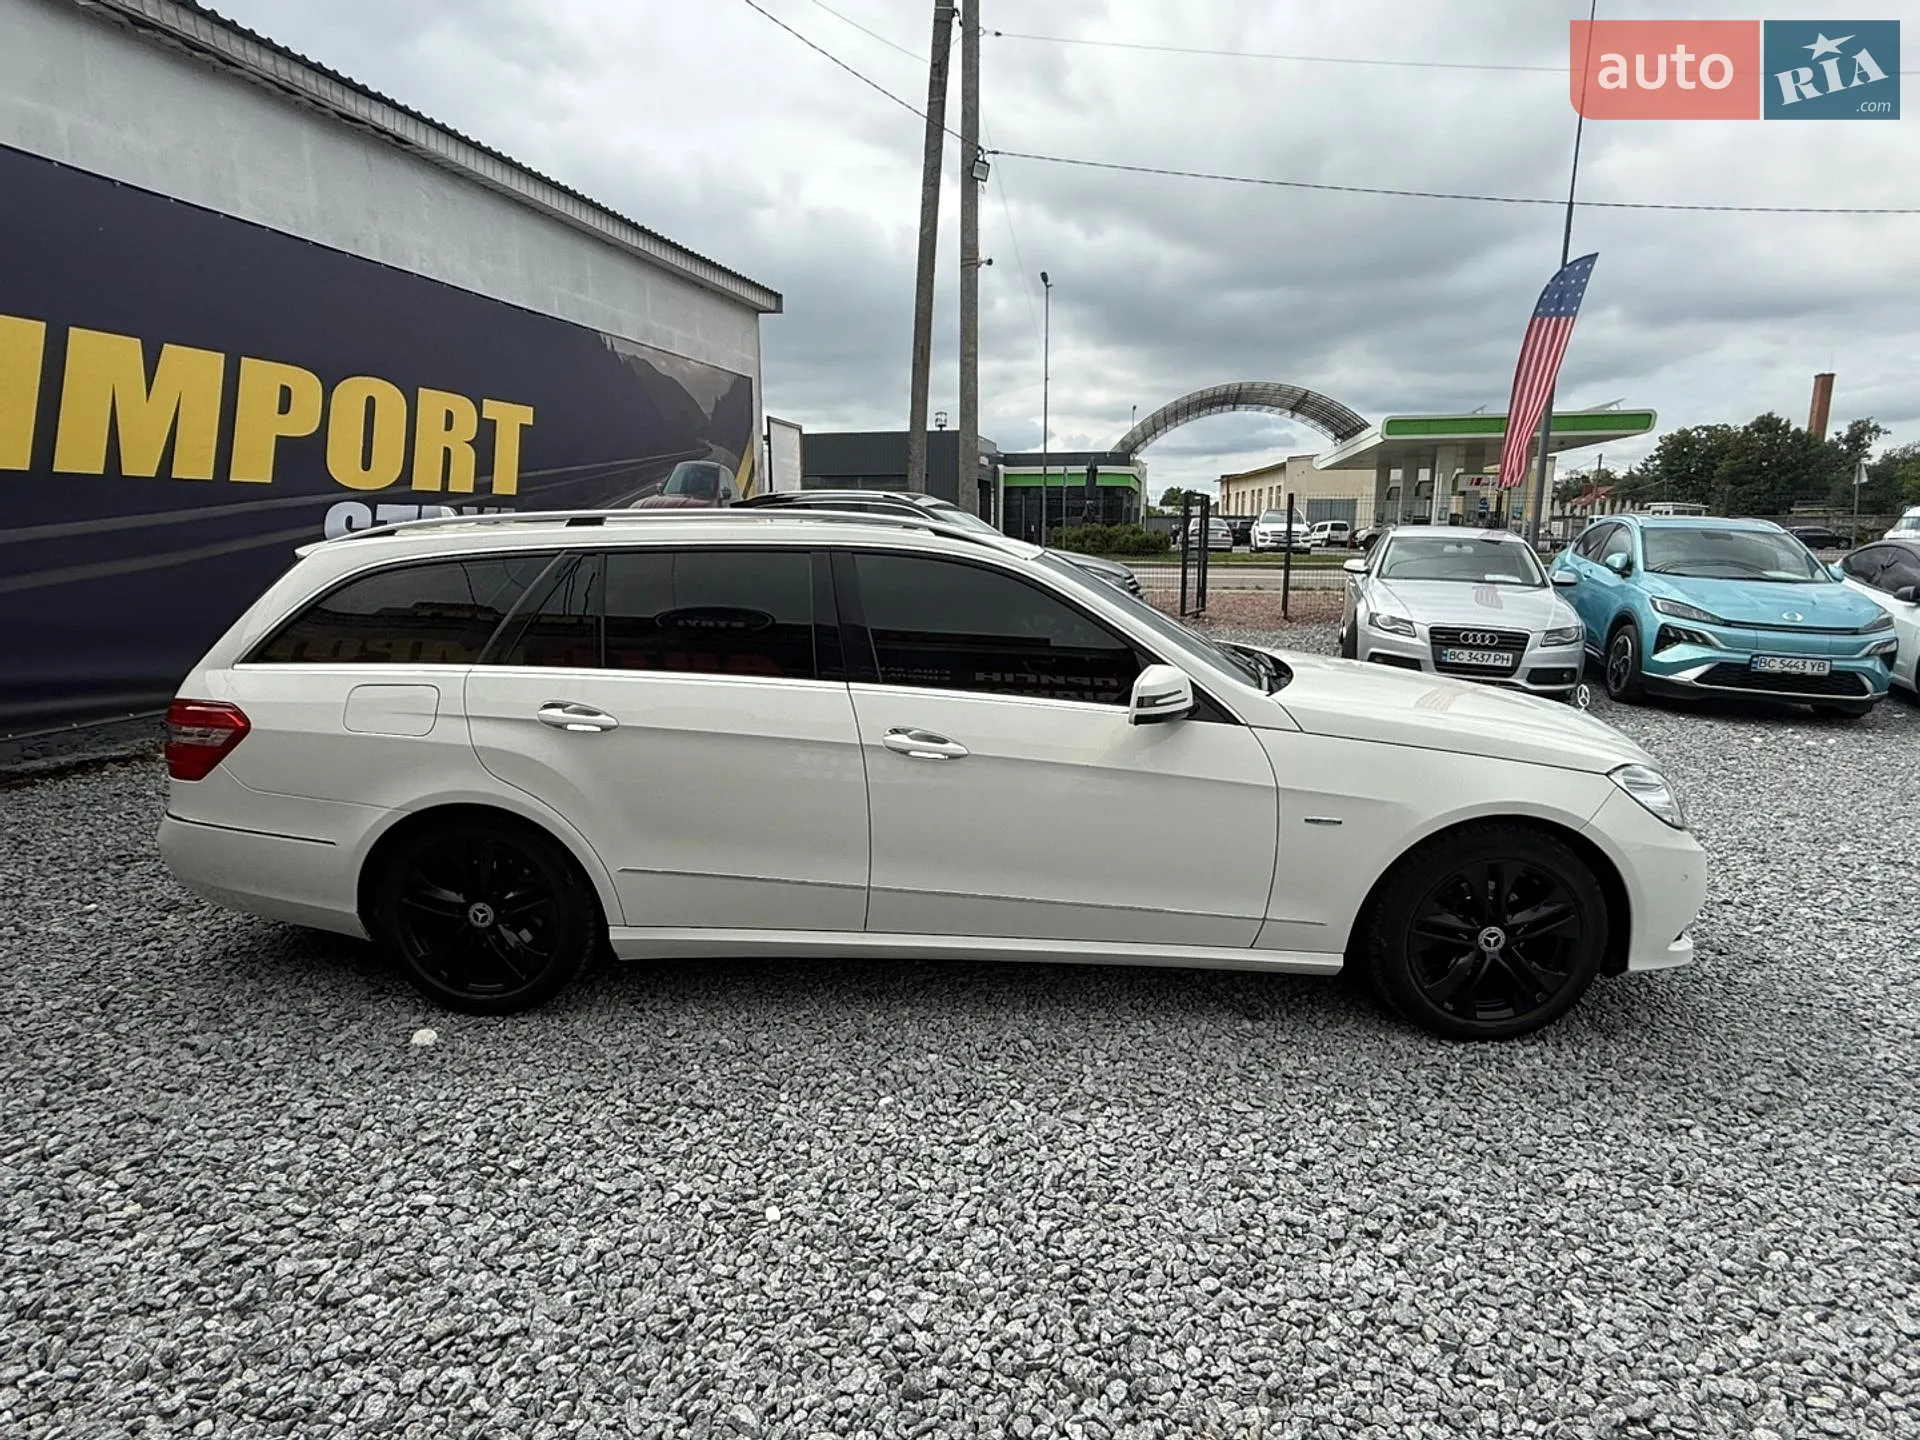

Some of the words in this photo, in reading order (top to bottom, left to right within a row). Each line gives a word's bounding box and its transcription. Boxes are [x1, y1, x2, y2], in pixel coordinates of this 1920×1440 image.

[0, 314, 534, 495] IMPORT
[1449, 650, 1464, 662] BC
[1466, 651, 1492, 663] 3437
[1493, 653, 1510, 665] PH
[1759, 657, 1776, 669] BC
[1779, 659, 1807, 671] 5443
